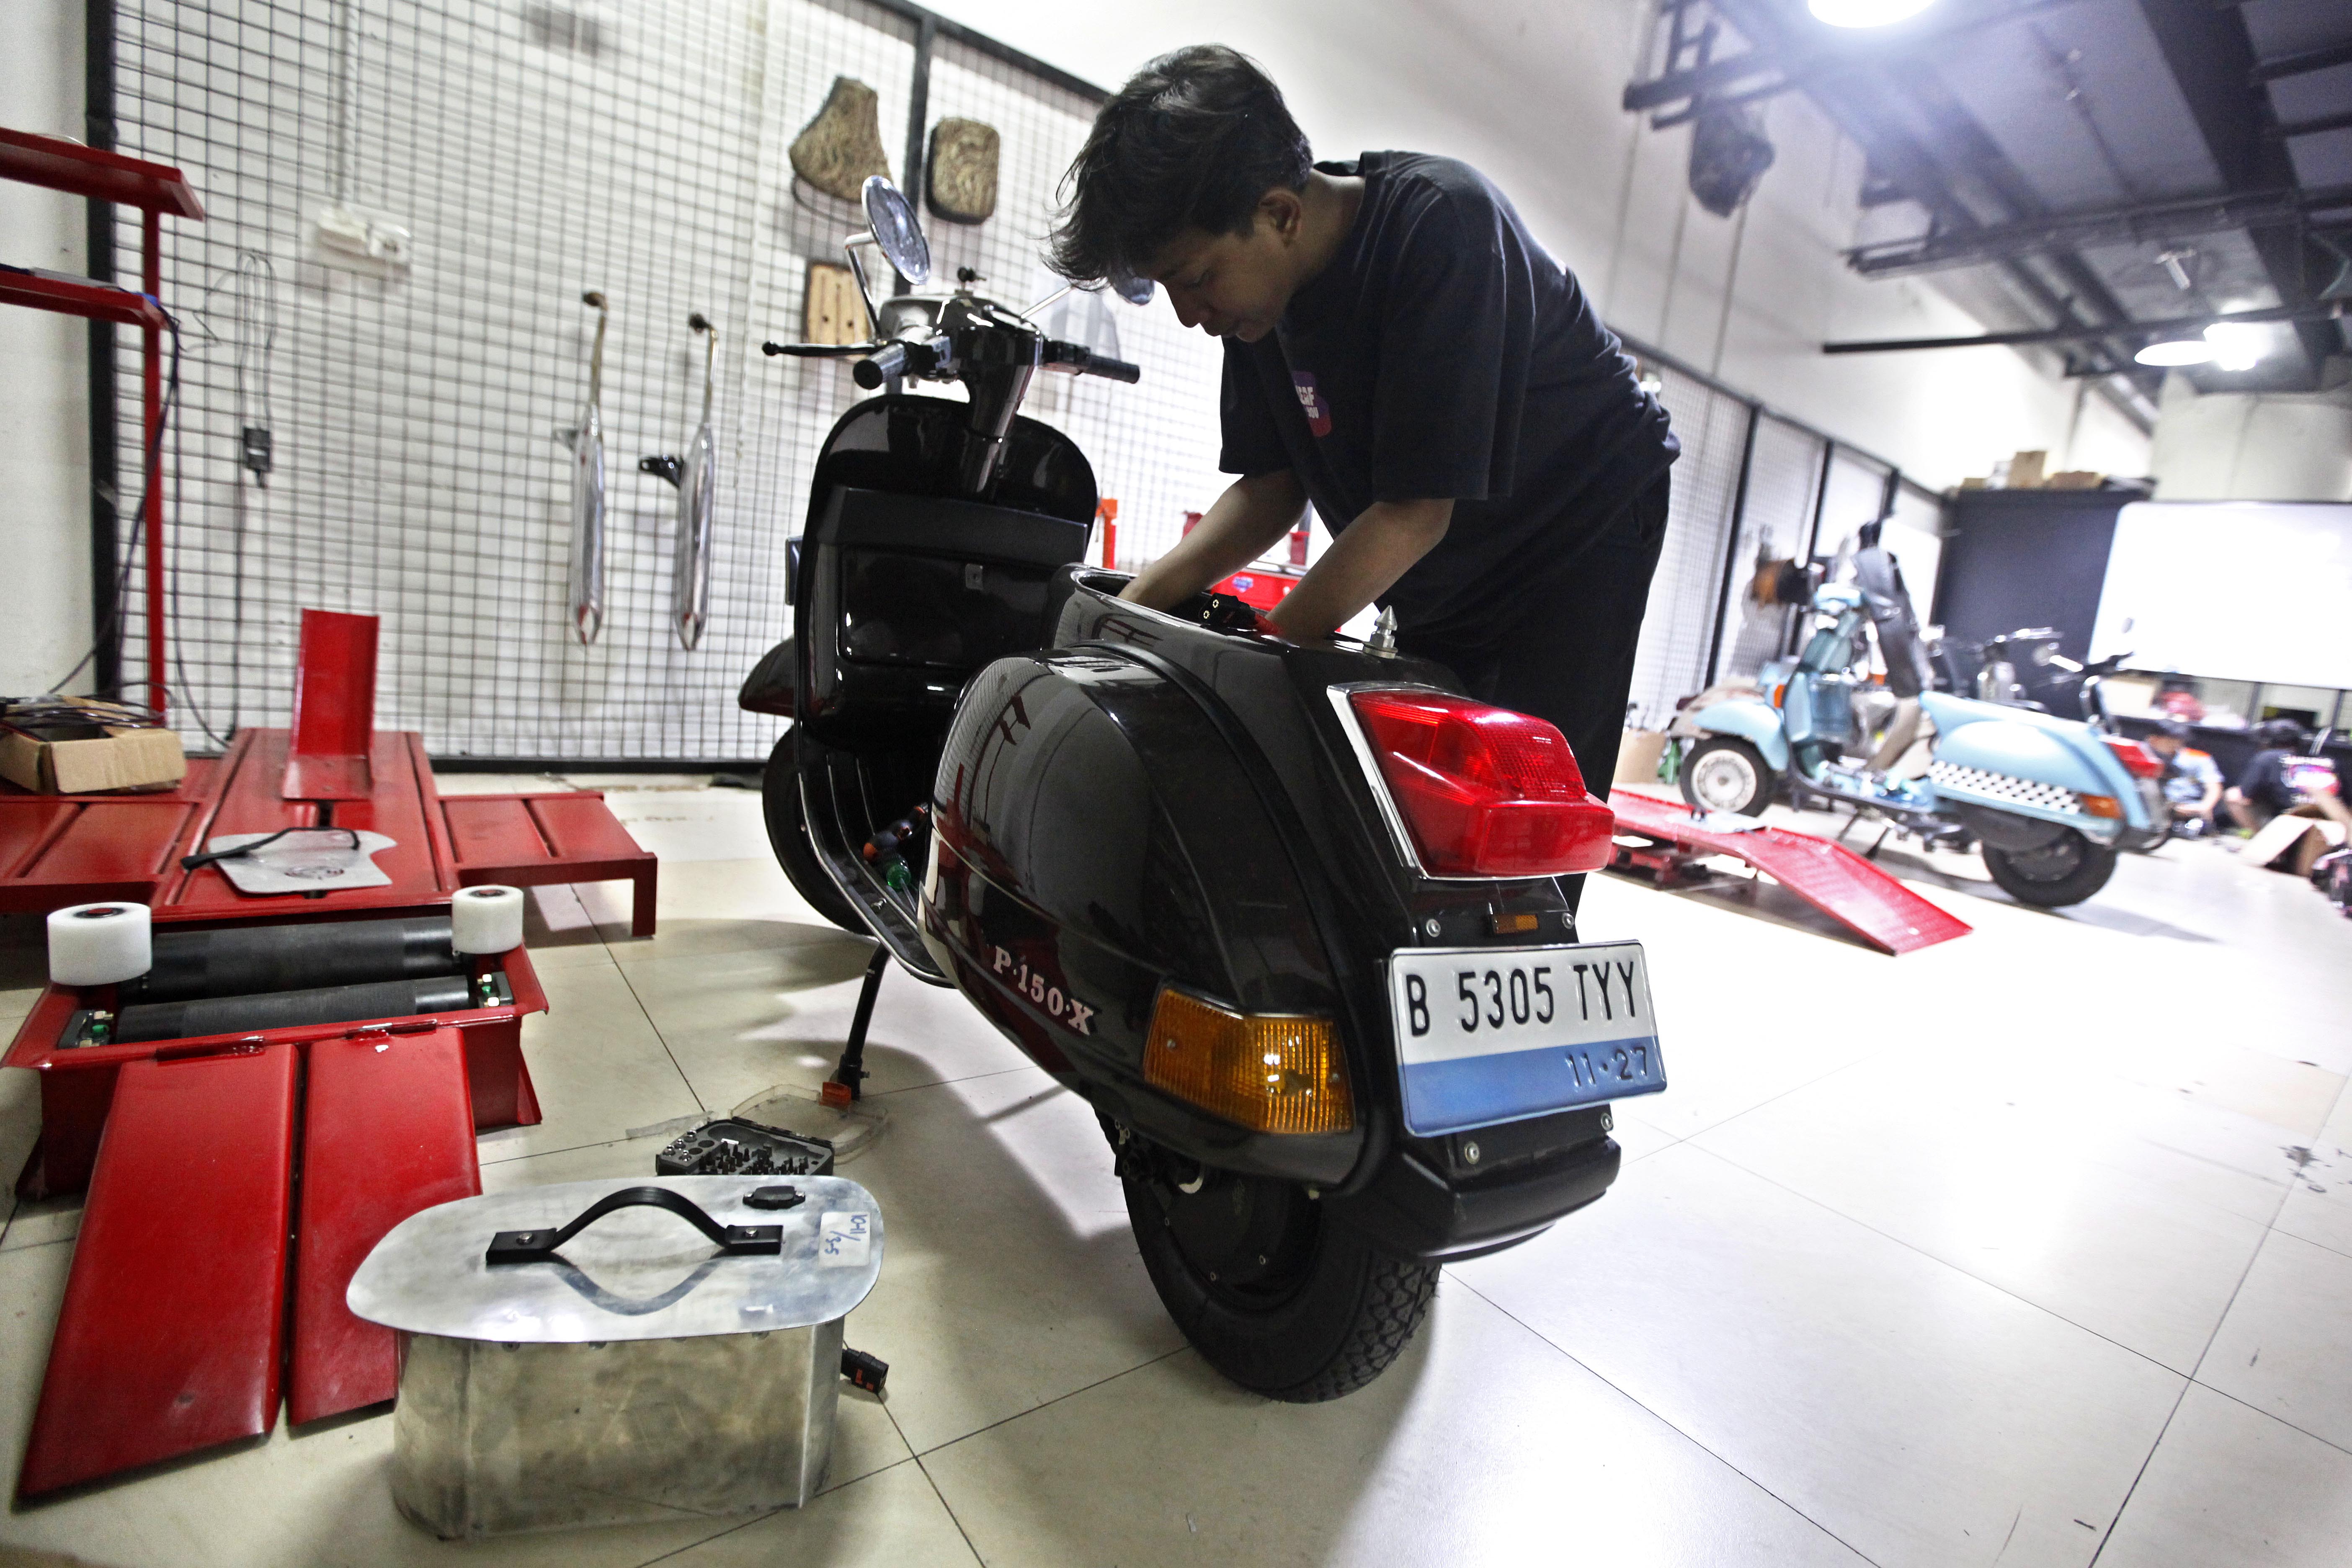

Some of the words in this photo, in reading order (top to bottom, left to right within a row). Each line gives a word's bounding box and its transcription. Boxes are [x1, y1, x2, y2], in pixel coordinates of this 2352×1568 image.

[1406, 974, 1430, 1037] B
[1458, 967, 1554, 1033] 5305
[1573, 961, 1636, 1021] TYY
